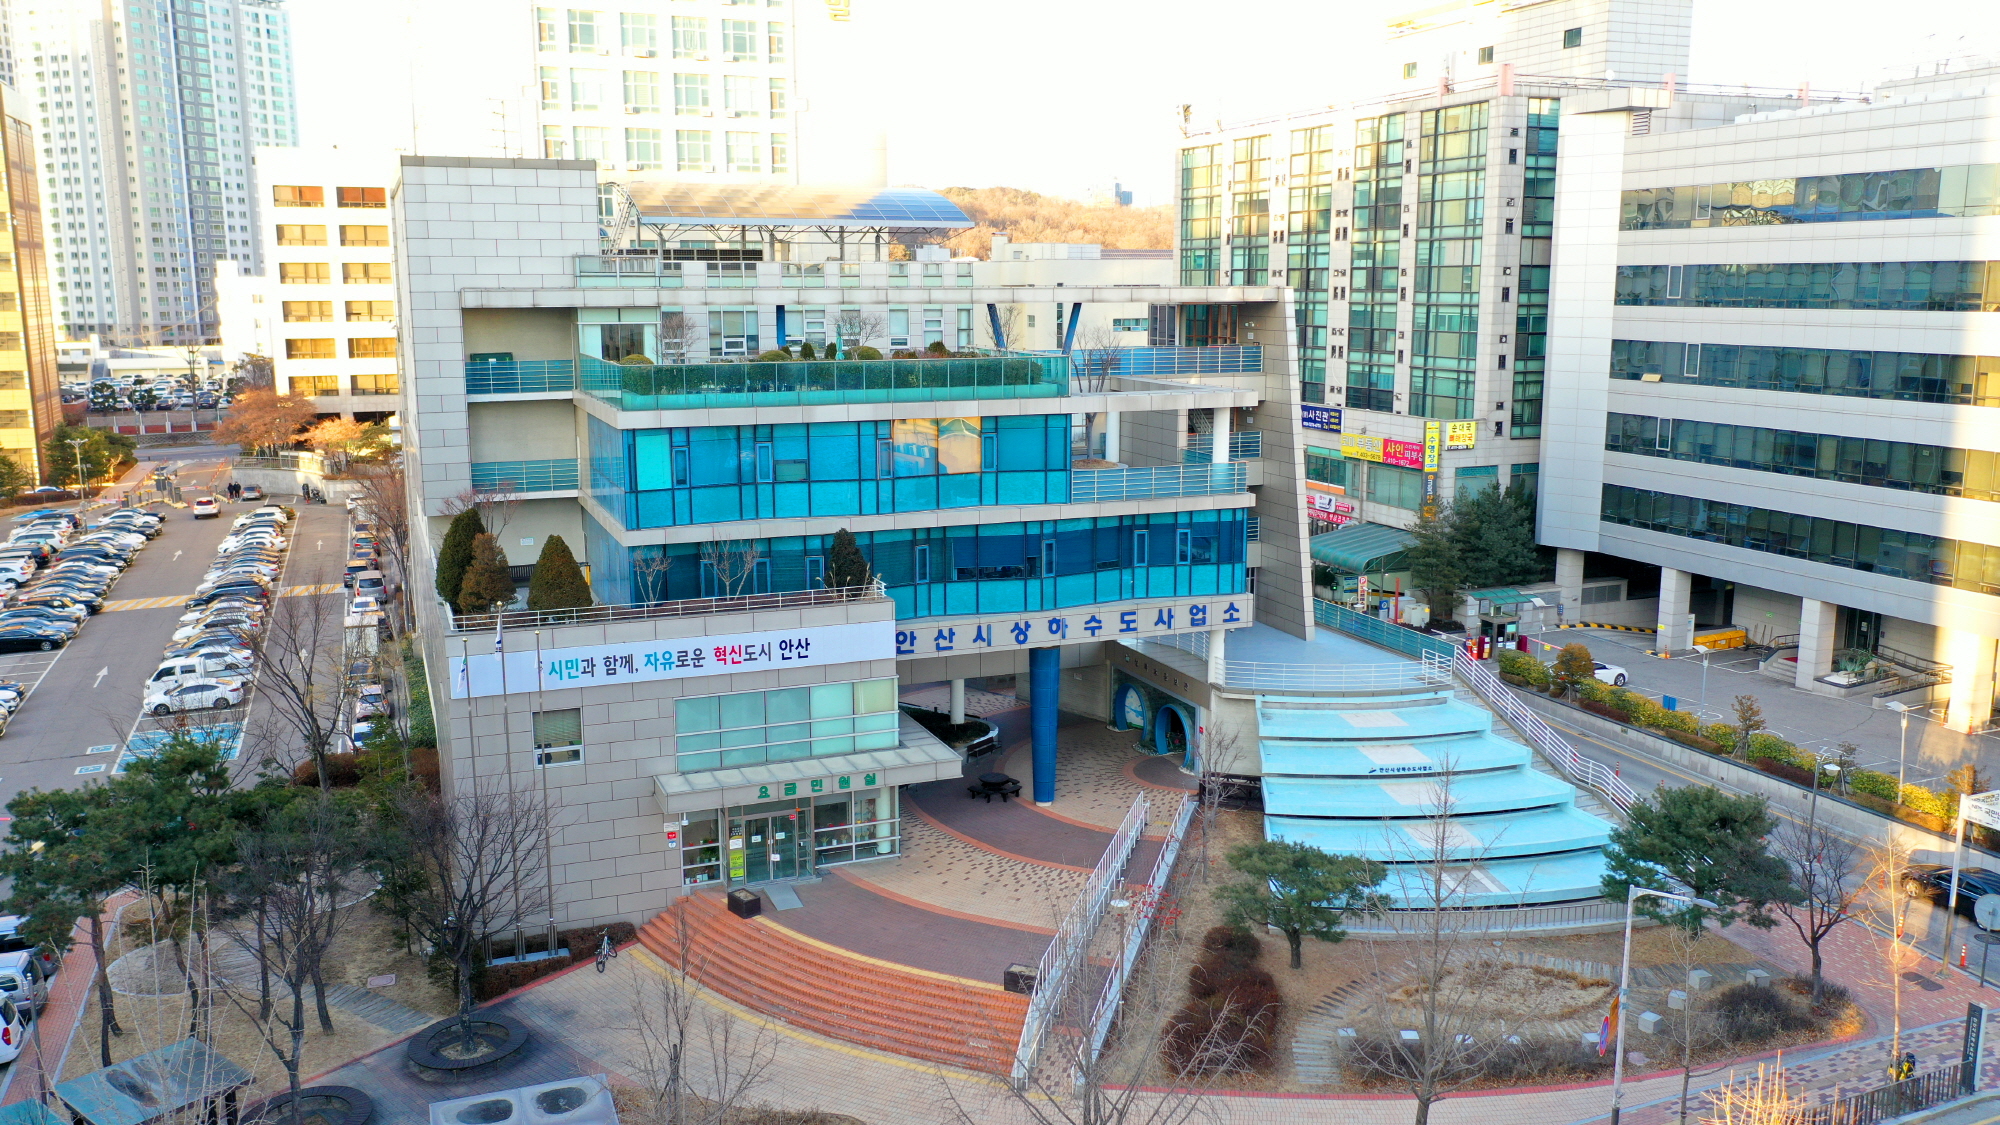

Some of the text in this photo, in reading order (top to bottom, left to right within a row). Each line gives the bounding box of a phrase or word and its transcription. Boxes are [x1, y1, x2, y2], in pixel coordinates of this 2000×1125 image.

[1357, 437, 1382, 453] 부동산
[1386, 442, 1404, 457] 샤인
[1428, 435, 1436, 463] 수영장
[896, 602, 1240, 654] 안산시상하수도사업소
[548, 637, 810, 681] 시민과 함께, 자유로운 혁신도시 안산
[757, 773, 877, 799] 요금민원실
